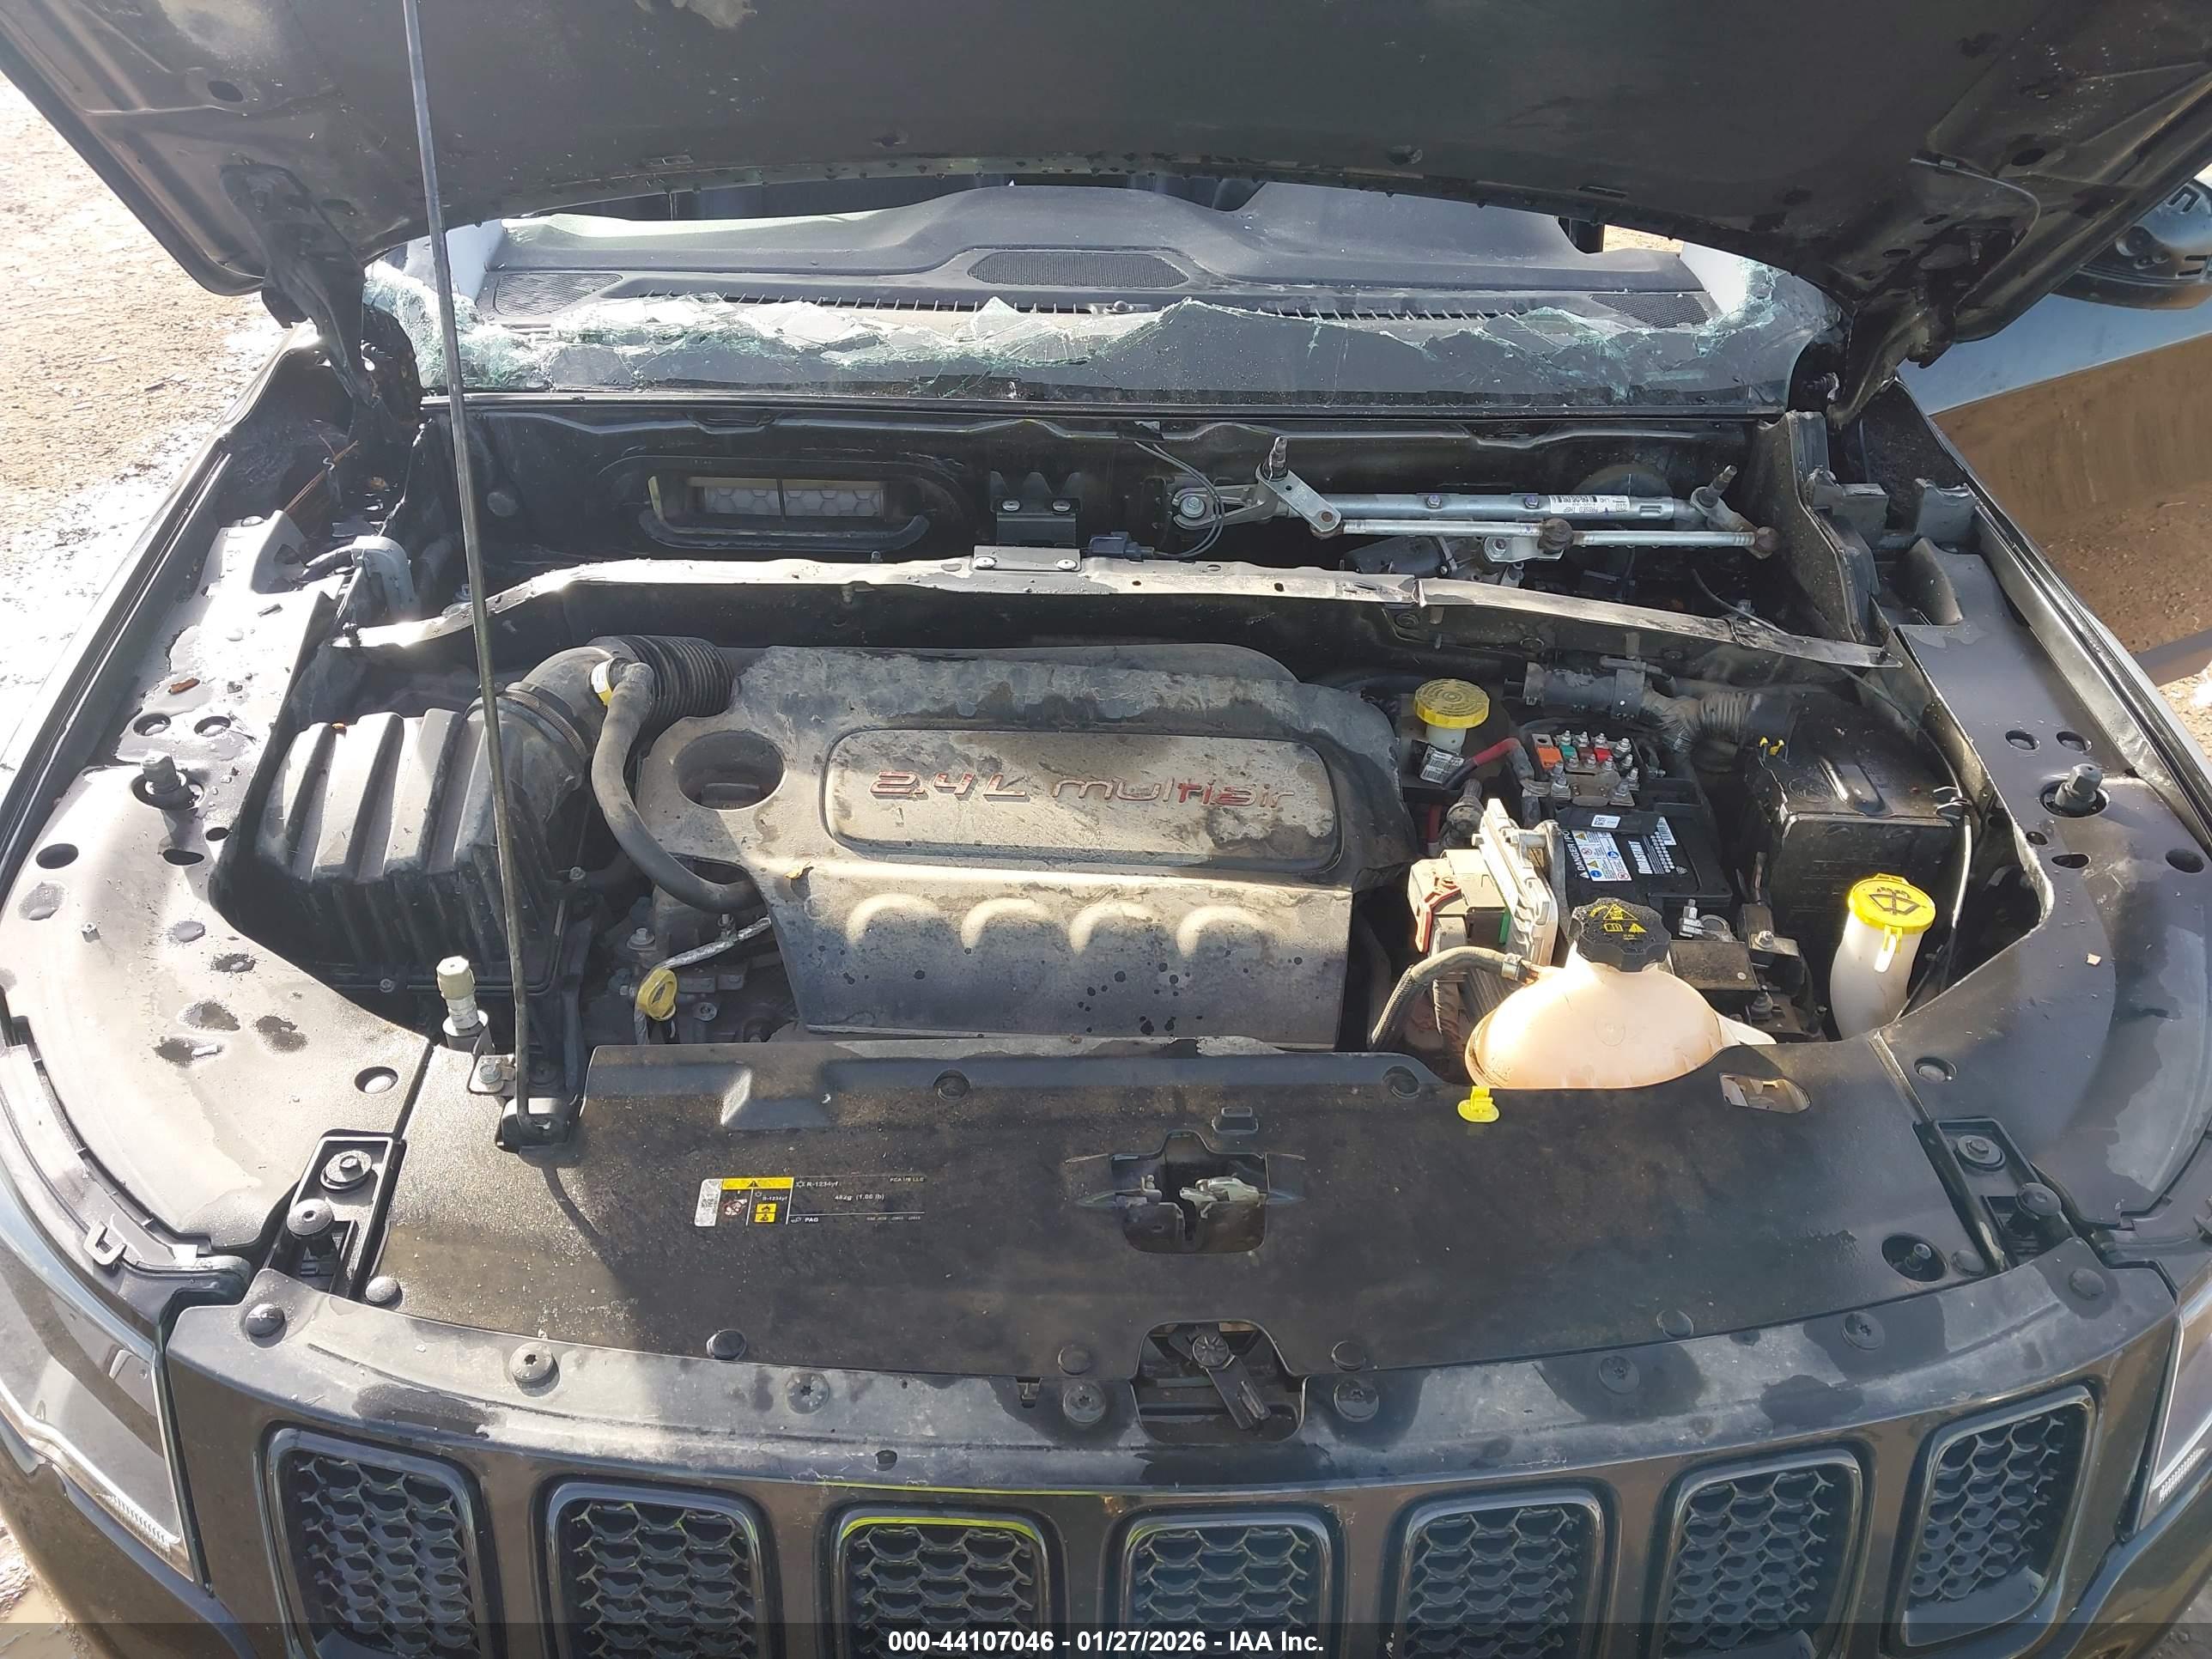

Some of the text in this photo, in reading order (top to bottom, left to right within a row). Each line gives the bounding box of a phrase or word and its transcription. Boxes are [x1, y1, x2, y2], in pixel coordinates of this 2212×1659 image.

[870, 771, 1029, 800] 2.4L
[1567, 843, 1586, 871] DANGER
[1628, 840, 1653, 874] DURASTART
